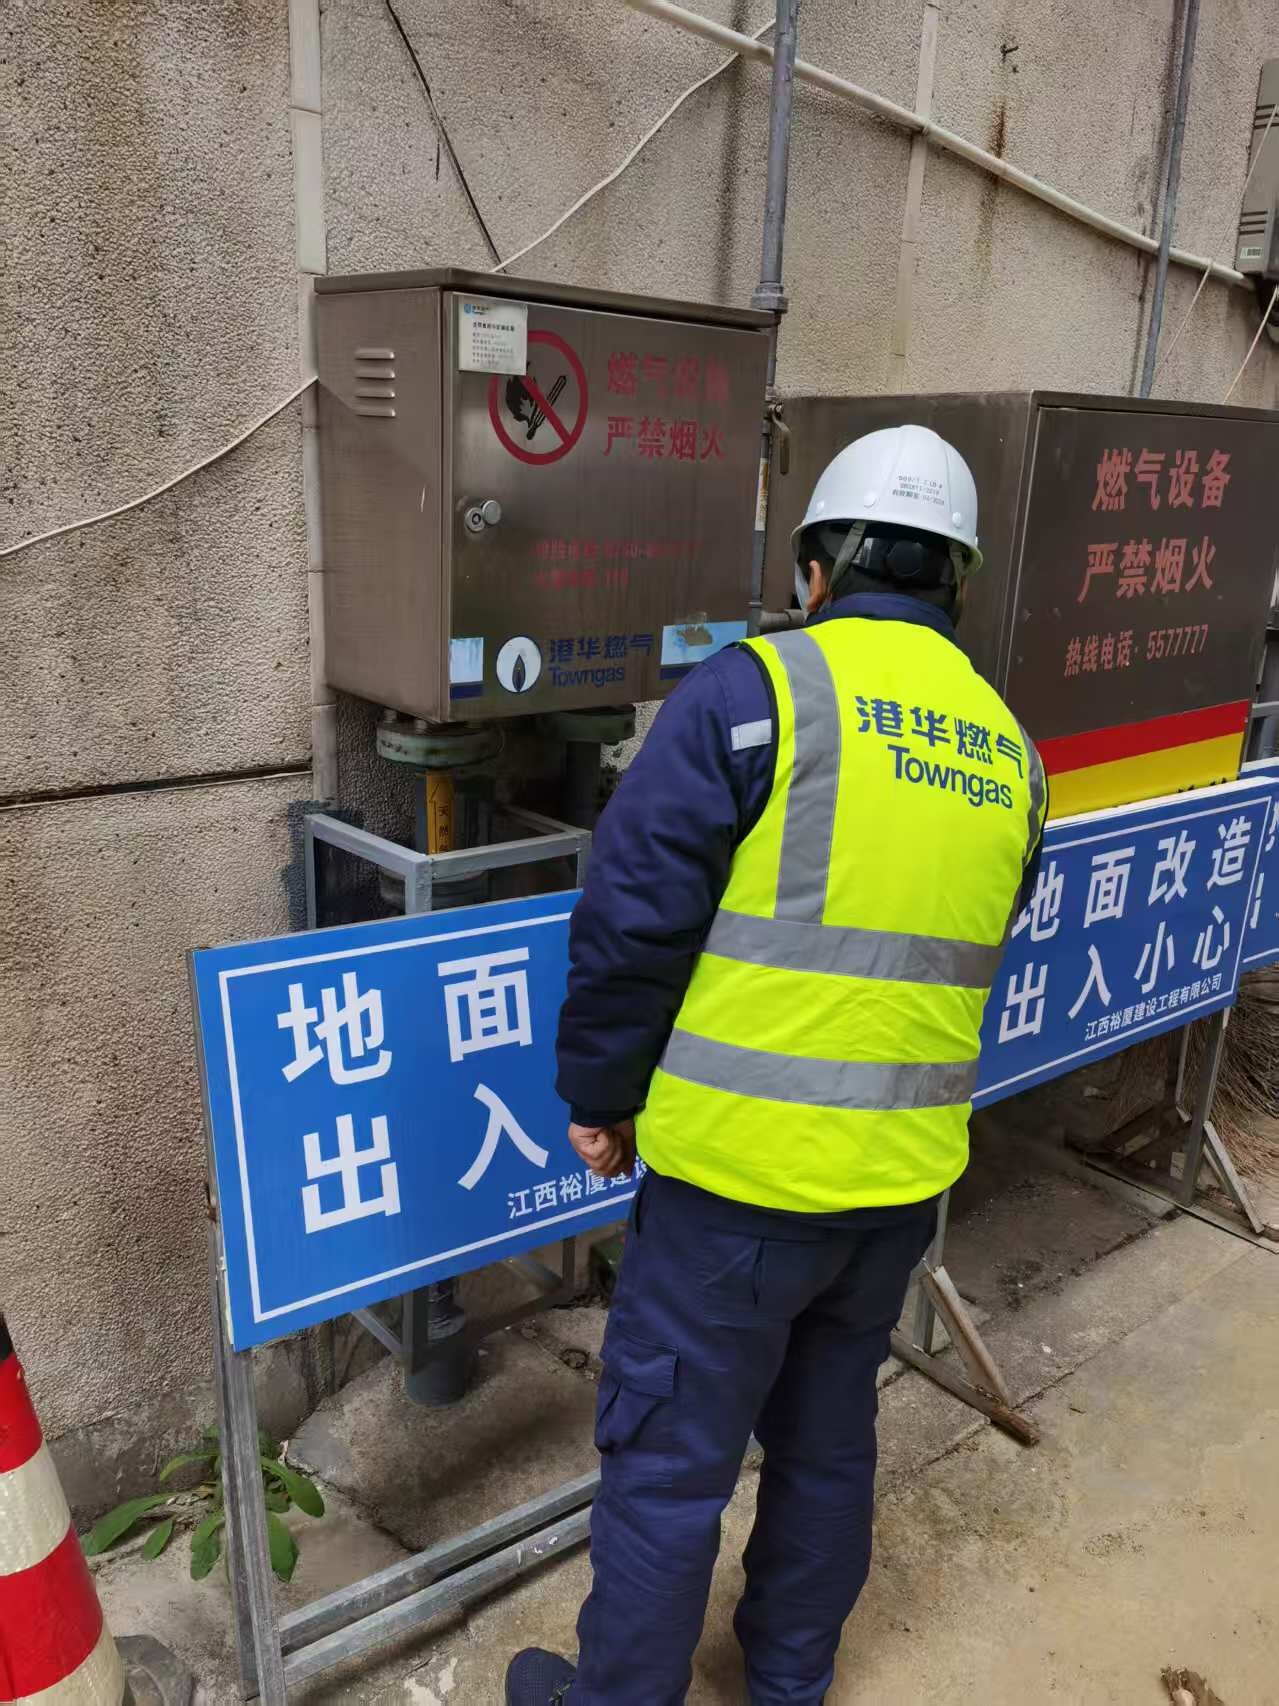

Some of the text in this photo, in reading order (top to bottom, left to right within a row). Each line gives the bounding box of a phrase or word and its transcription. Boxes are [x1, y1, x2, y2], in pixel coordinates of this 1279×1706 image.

[603, 416, 725, 460] 严禁烟火
[1092, 448, 1231, 511] 燃气设备
[1077, 536, 1216, 603] 严禁烟火
[549, 634, 654, 662] 港华燃气
[549, 666, 625, 688] Towngas
[854, 695, 1023, 779] 港华燃气
[887, 744, 1013, 809] Towngas
[998, 906, 1230, 1044] 出入小心
[1084, 972, 1222, 1041] 江西裕厦建设工程有限公司
